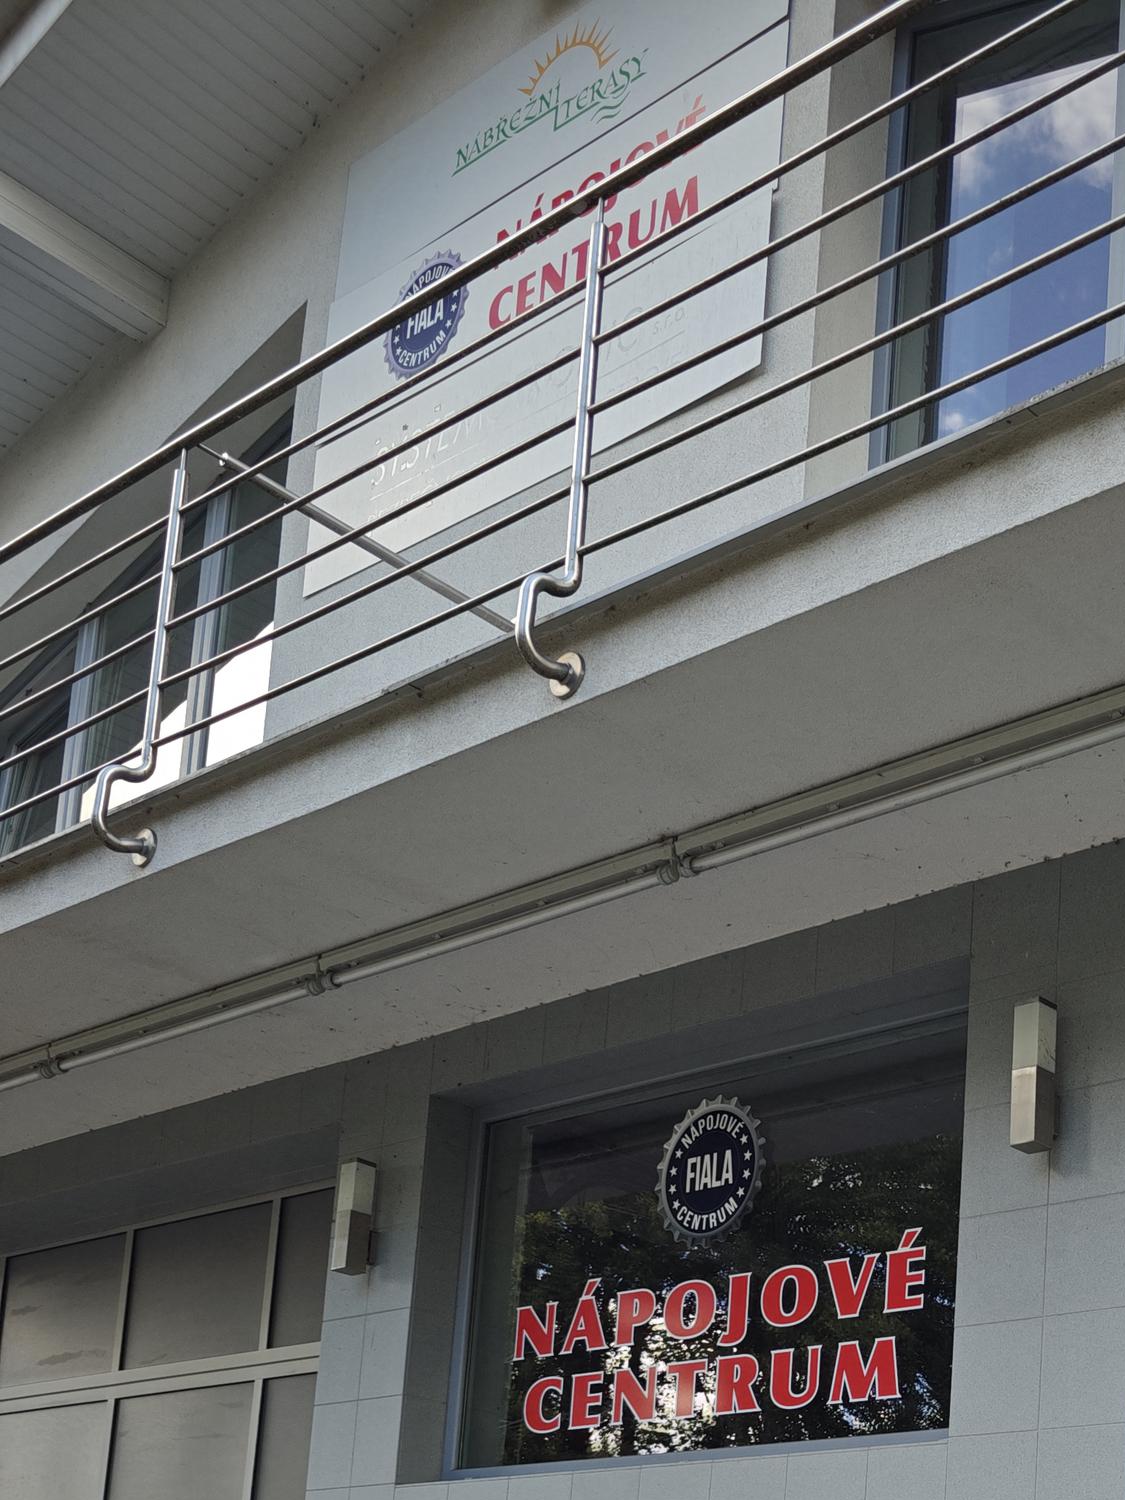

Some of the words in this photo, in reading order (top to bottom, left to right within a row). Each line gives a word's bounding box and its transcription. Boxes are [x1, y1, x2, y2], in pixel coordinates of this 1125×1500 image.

[455, 77, 561, 170] NÁBŘEŽNÍ
[398, 329, 447, 368] CENTRUM
[681, 1113, 745, 1149] NÁPOJOVÉ
[685, 1149, 734, 1193] FIALA
[676, 1196, 738, 1230] CENTRUM
[513, 1227, 926, 1361] NÁPOJOVÉ
[524, 1336, 902, 1433] CENTRUM
